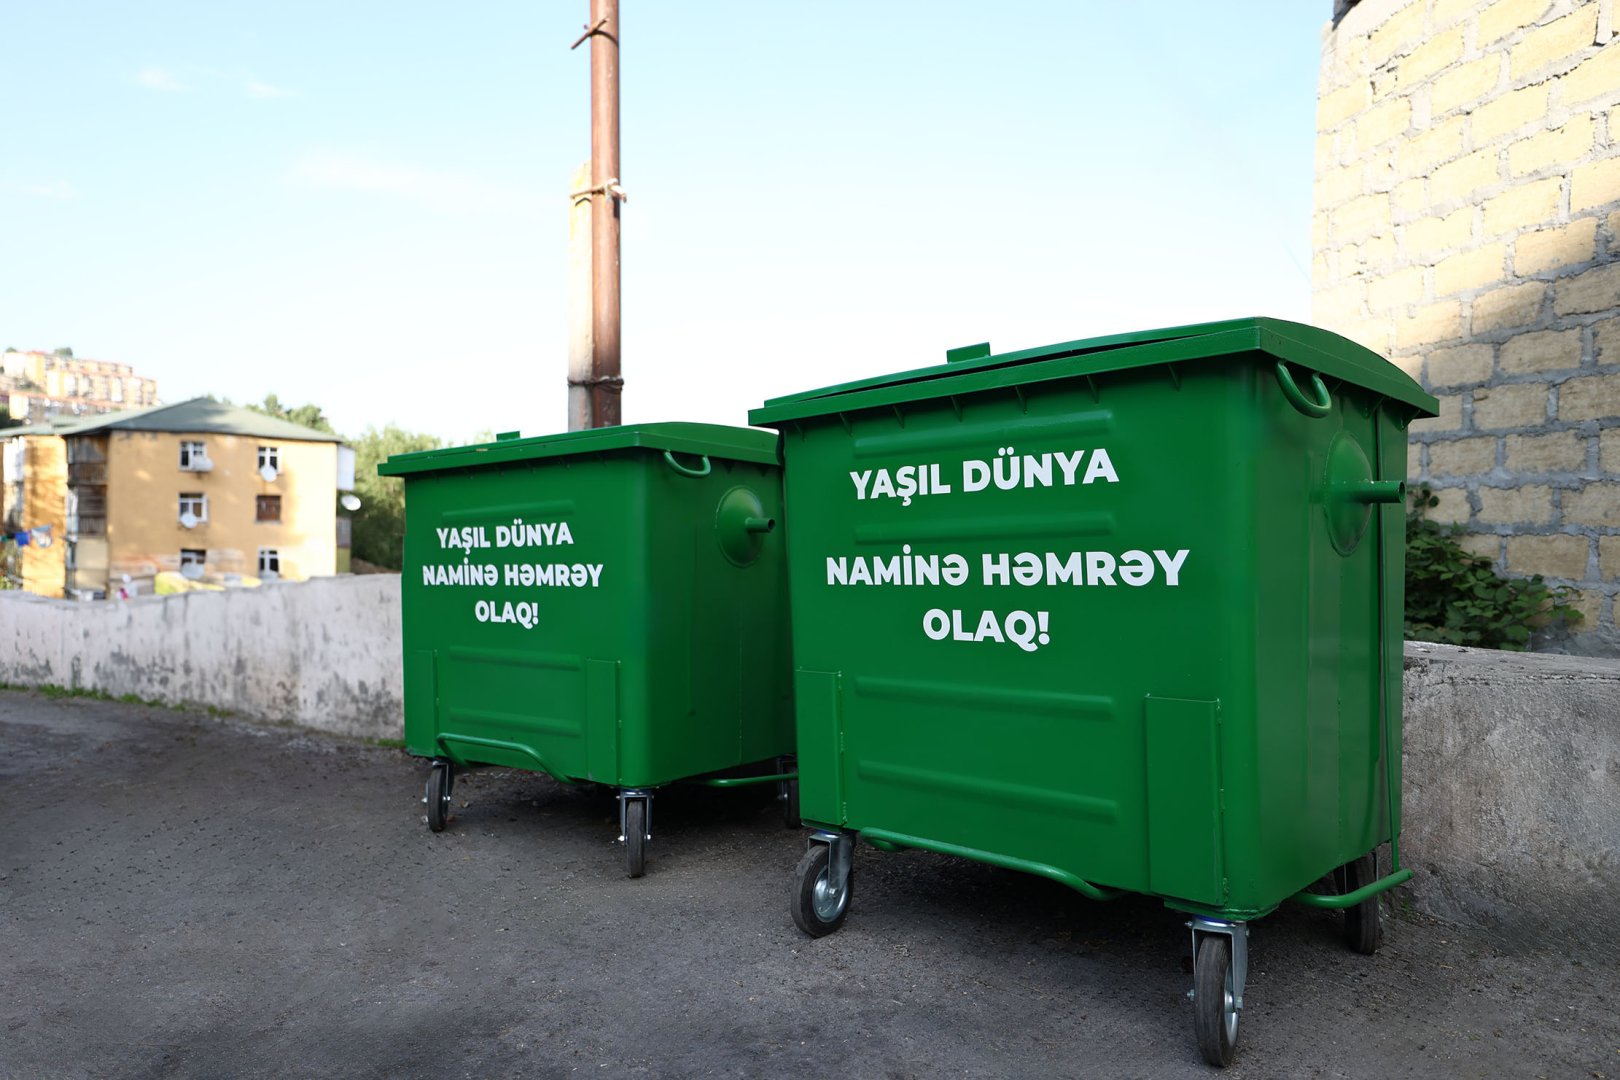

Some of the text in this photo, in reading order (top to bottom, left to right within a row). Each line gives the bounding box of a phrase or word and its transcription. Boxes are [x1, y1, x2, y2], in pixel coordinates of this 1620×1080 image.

[850, 446, 1120, 507] YAŞIL DÜNYA
[436, 518, 574, 555] YAŞIL DÜNYA
[422, 557, 604, 588] NAMİNƏ HƏMRƏY
[826, 544, 1190, 587] NAMİNƏ HƏMRƏY
[475, 600, 539, 630] OLAQ!
[922, 608, 1050, 652] OLAQ!
